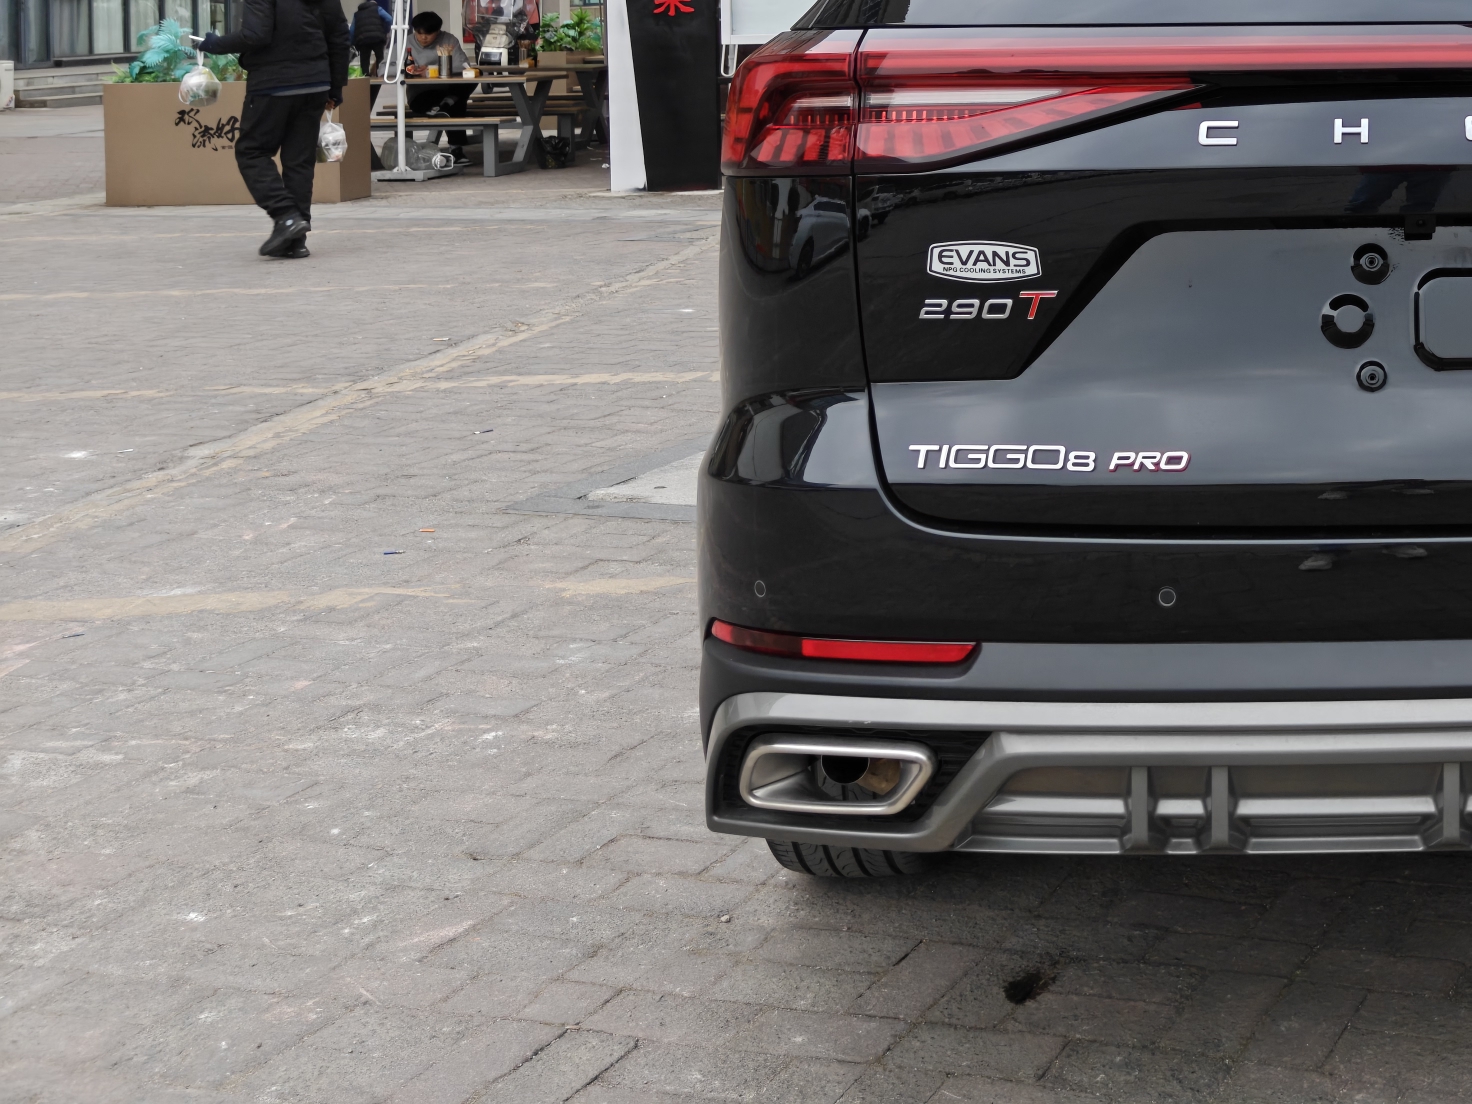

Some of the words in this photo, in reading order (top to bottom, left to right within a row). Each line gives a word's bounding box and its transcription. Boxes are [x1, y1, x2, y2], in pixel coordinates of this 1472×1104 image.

[937, 248, 1031, 268] EVANS
[960, 266, 991, 274] COOLING
[993, 267, 1027, 275] SYSTEMS
[1108, 451, 1191, 473] PRO
